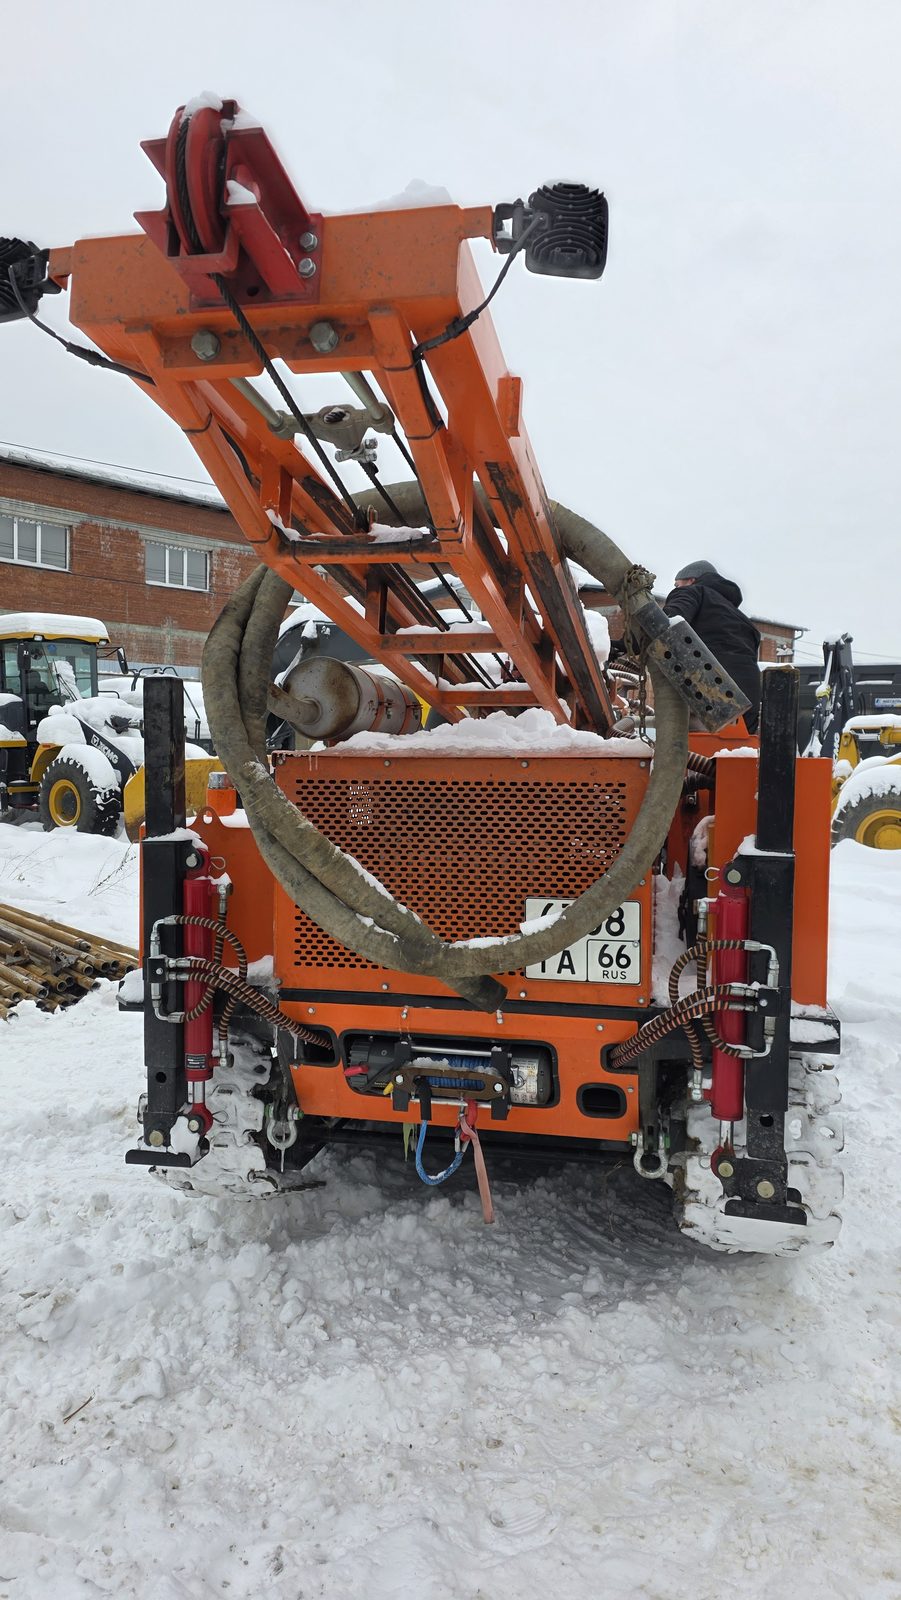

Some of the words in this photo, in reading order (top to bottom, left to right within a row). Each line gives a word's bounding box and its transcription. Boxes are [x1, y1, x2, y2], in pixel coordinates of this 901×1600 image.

[98, 741, 119, 764] XCMG
[598, 944, 631, 969] 66
[602, 970, 627, 980] RUS
